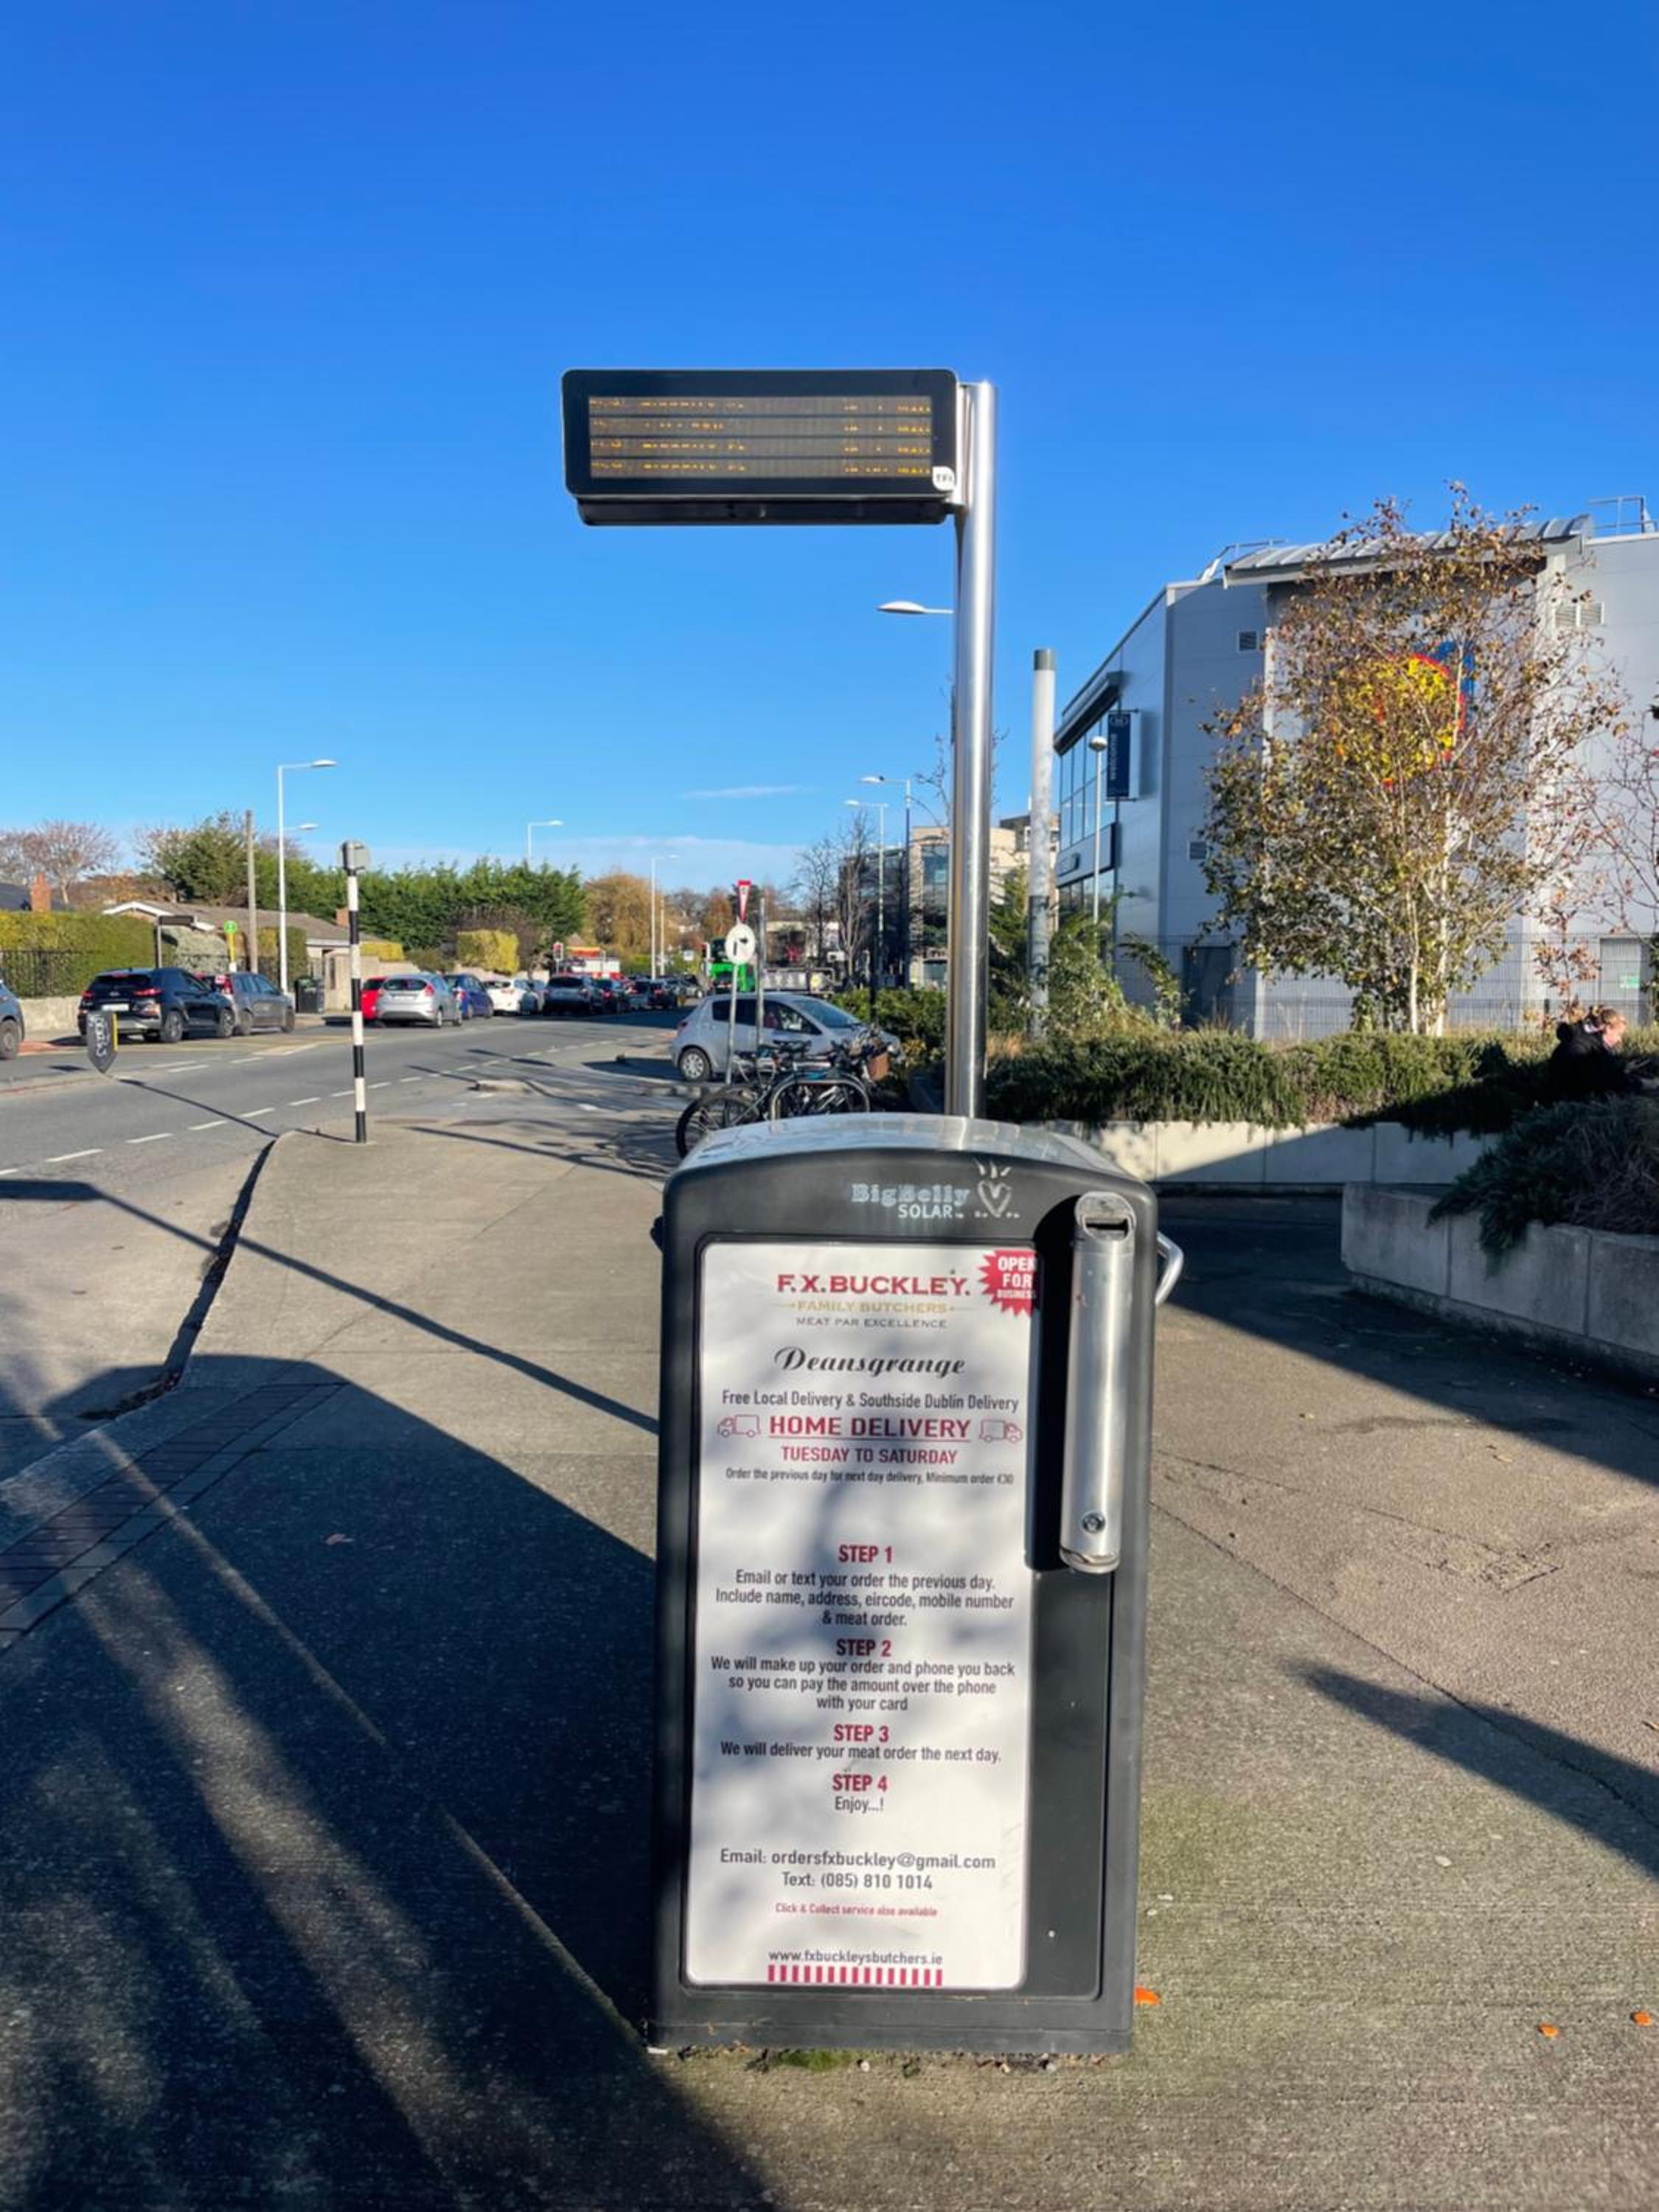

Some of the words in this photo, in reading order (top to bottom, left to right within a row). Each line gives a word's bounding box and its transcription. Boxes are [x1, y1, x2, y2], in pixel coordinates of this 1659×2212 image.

[851, 1183, 971, 1207] BigBelly
[897, 1203, 953, 1219] SOLAR
[1002, 1273, 1033, 1288] FOR
[797, 1300, 855, 1313] FAMILY
[860, 1300, 947, 1315] BUTCHERS
[796, 1317, 830, 1326] MEAT
[835, 1318, 860, 1328] PAR
[863, 1318, 947, 1329] EXCELLENCE
[775, 1347, 964, 1378] Deansgrange
[723, 1390, 751, 1405] Free
[754, 1389, 787, 1405] Local
[791, 1391, 843, 1411] Delivery
[846, 1394, 855, 1407] &
[859, 1392, 921, 1408] Southside
[925, 1394, 964, 1409] Dublin
[967, 1394, 1019, 1413] Delivery
[771, 1416, 841, 1436] HOME
[849, 1417, 970, 1438] DELIVERY
[782, 1447, 850, 1462] TUESDAY
[854, 1447, 874, 1463] TO
[879, 1445, 956, 1464] SATURDAY
[726, 1467, 751, 1479] Order
[753, 1469, 768, 1479] the
[770, 1469, 809, 1481] previous
[811, 1470, 829, 1484] day
[844, 1470, 866, 1484] next
[867, 1470, 885, 1484] day
[970, 1474, 995, 1484] order
[838, 1545, 879, 1563] STEP
[885, 1545, 892, 1563] 1
[736, 1569, 771, 1585] Email
[774, 1573, 788, 1585] or
[791, 1570, 816, 1586] text
[818, 1572, 848, 1591] your
[850, 1573, 885, 1587] order
[888, 1573, 908, 1588] the
[912, 1574, 967, 1591] previous
[970, 1574, 995, 1593] day.
[716, 1587, 762, 1604] Include
[766, 1592, 805, 1607] name,
[808, 1590, 862, 1607] address,
[865, 1592, 916, 1609] eircode,
[919, 1593, 961, 1608] mobile
[965, 1594, 1015, 1609] number
[822, 1610, 832, 1625] &
[835, 1610, 869, 1628] meat
[870, 1612, 906, 1629] order.
[835, 1638, 877, 1657] STEP
[880, 1640, 891, 1657] 2
[711, 1656, 730, 1670] We
[734, 1656, 757, 1670] will
[760, 1658, 796, 1672] make
[799, 1660, 815, 1675] up
[819, 1658, 848, 1674] your
[849, 1658, 884, 1674] order
[888, 1661, 911, 1674] and
[915, 1660, 955, 1678] phone
[957, 1664, 981, 1679] you
[984, 1662, 1015, 1676] back
[728, 1677, 744, 1688] so
[748, 1677, 771, 1691] you
[773, 1677, 797, 1689] can
[801, 1679, 824, 1694] pay
[827, 1677, 848, 1691] the
[851, 1679, 899, 1692] amount
[902, 1681, 931, 1693] over
[933, 1679, 954, 1694] the
[957, 1680, 996, 1697] phone
[816, 1694, 844, 1709] with
[847, 1699, 876, 1713] your
[879, 1697, 908, 1711] card
[834, 1724, 874, 1742] STEP
[879, 1725, 889, 1743] 3
[720, 1741, 740, 1756] We
[743, 1742, 766, 1759] will
[770, 1742, 813, 1757] deliver
[816, 1746, 845, 1760] your
[848, 1746, 880, 1761] meat
[883, 1746, 917, 1760] order
[921, 1747, 942, 1760] the
[945, 1748, 973, 1761] next
[975, 1747, 1001, 1764] day.
[832, 1773, 872, 1792] STEP
[877, 1775, 887, 1792] 4
[835, 1795, 883, 1814] Enjoy...!
[720, 1848, 766, 1863] Email:
[771, 1850, 995, 1871] ordersfxbuckley@gmail.com
[782, 1871, 815, 1886] Text:
[821, 1872, 858, 1888] (085)
[863, 1874, 891, 1888] 810
[897, 1874, 932, 1890] 1014
[776, 1902, 798, 1913] Click
[799, 1904, 807, 1913] &
[810, 1903, 840, 1915] Collect
[842, 1906, 874, 1915] service
[897, 1907, 938, 1916] available
[768, 1950, 942, 1966] www.fxbuckleysbutchers.ie
